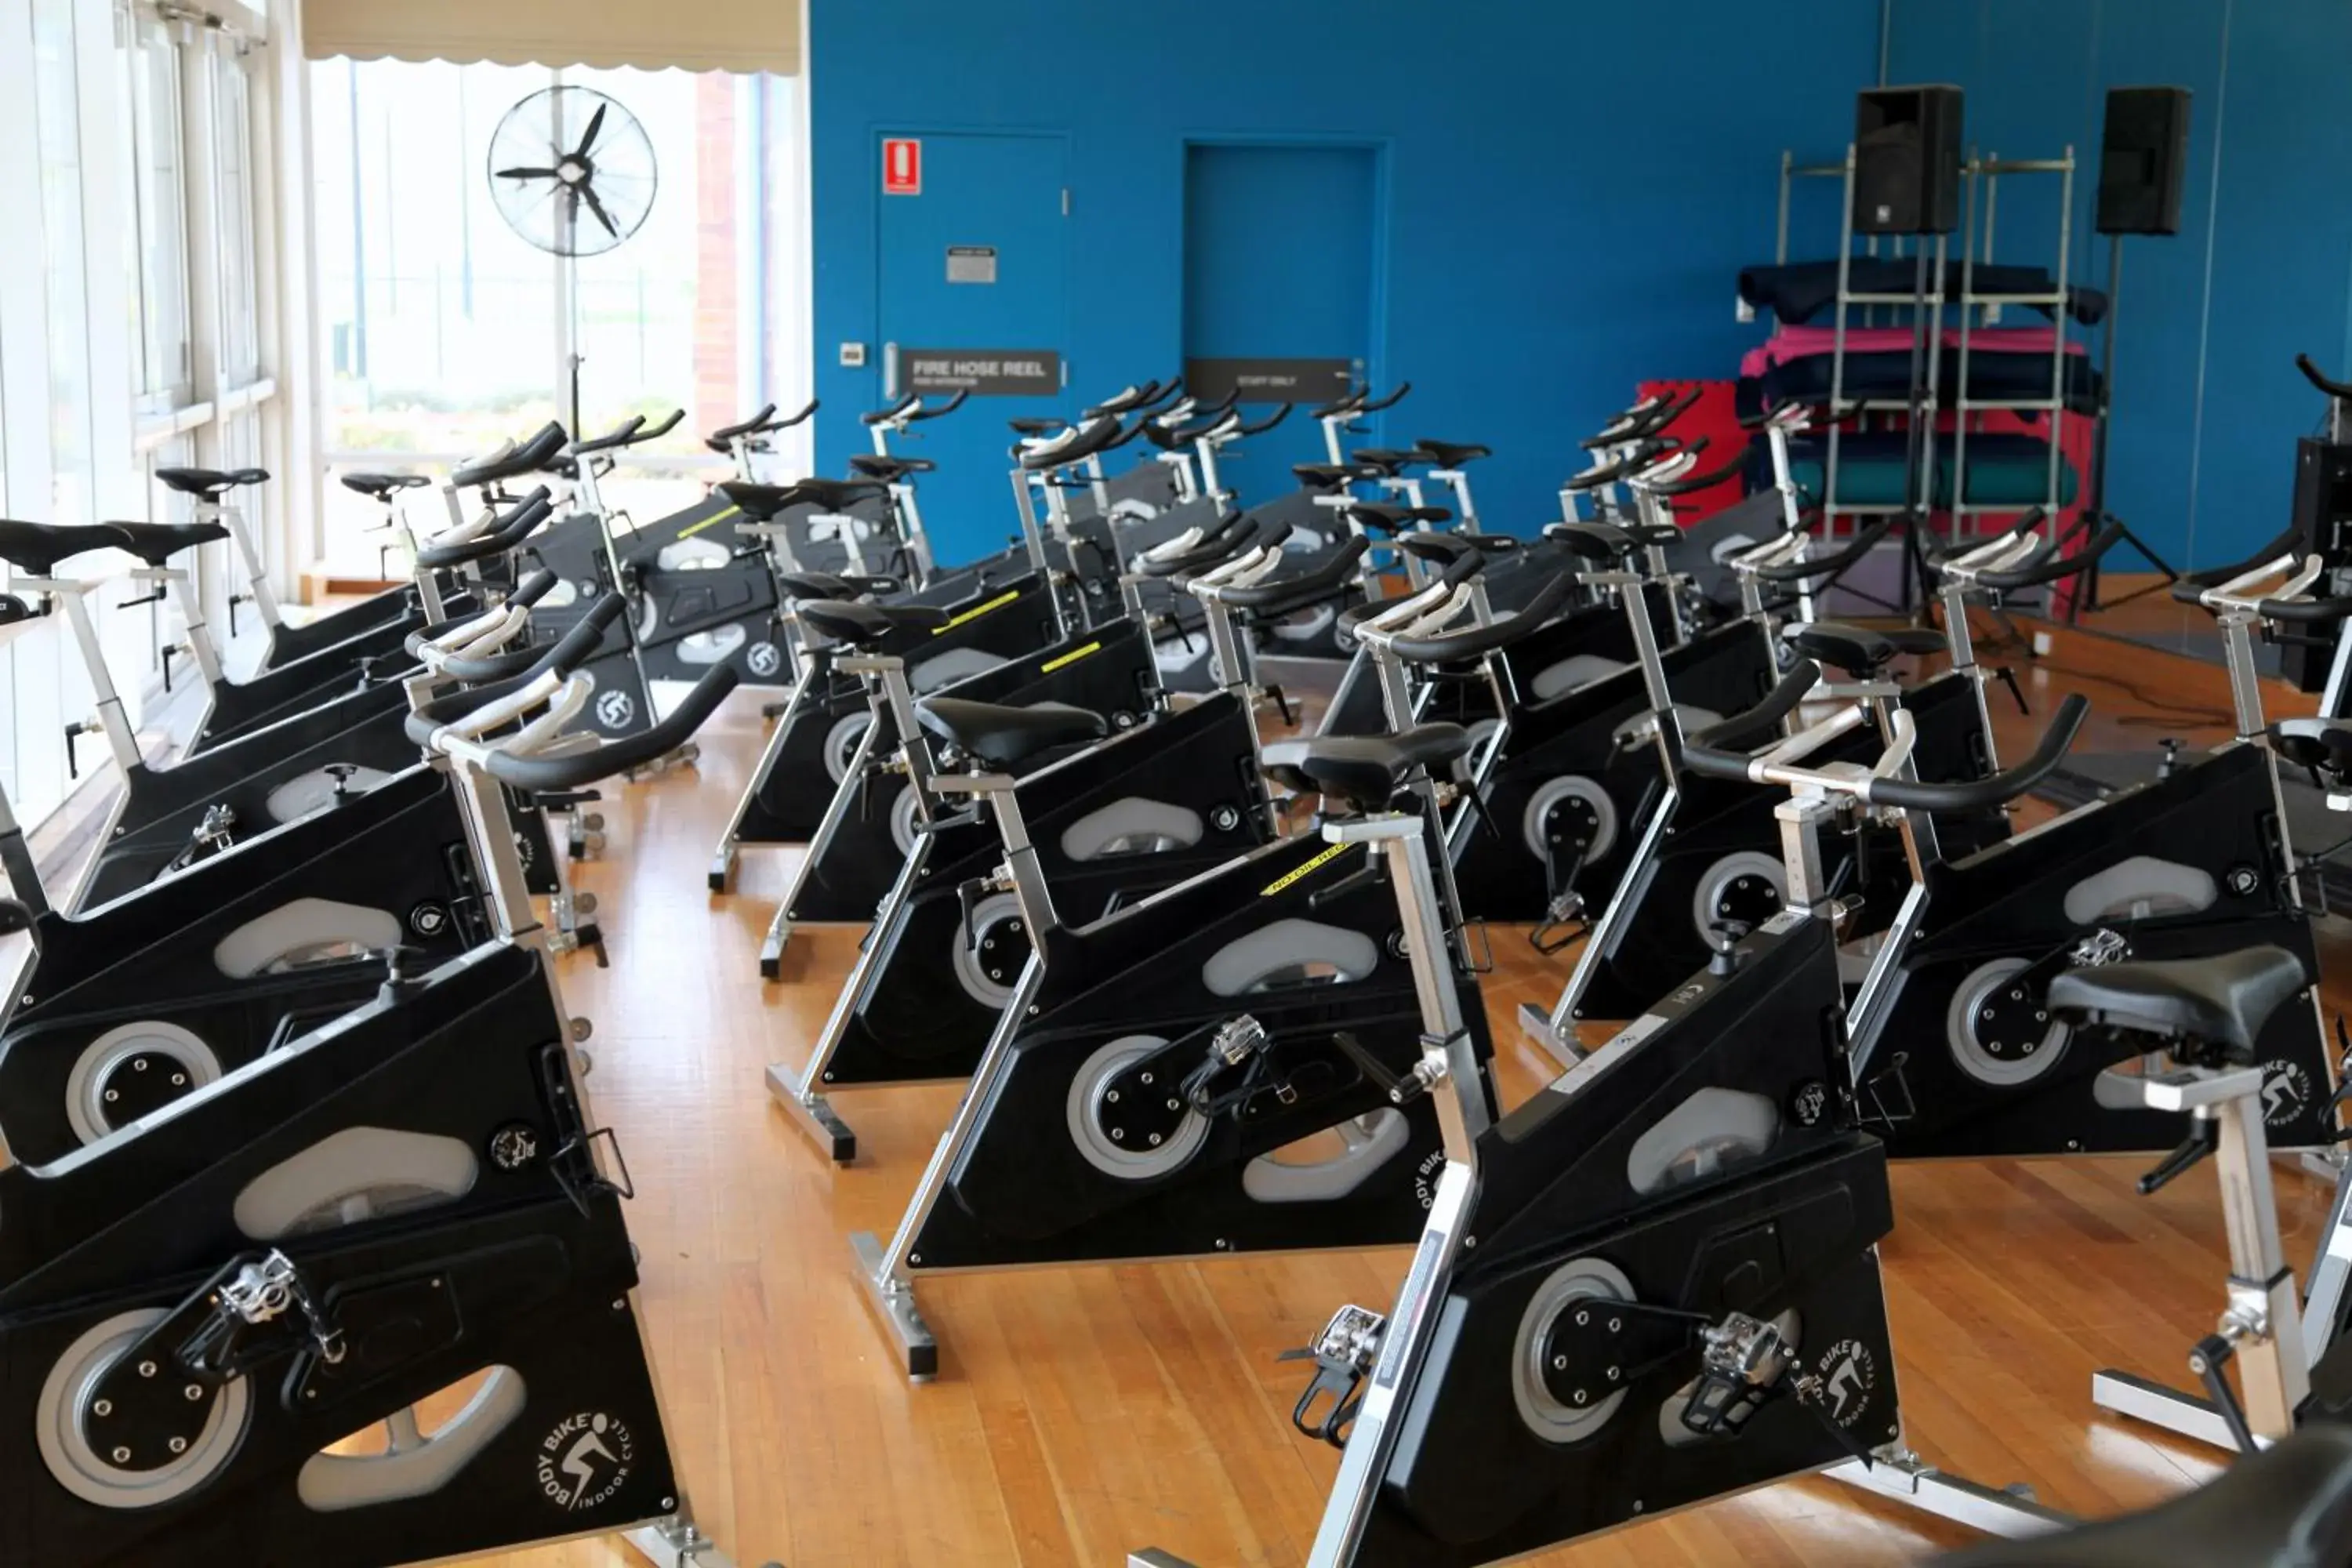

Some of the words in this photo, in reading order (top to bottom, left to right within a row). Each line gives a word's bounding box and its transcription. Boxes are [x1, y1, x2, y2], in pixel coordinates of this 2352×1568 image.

[913, 360, 950, 376] FIRE
[953, 360, 1000, 377] HOSE
[1003, 361, 1047, 378] REEL
[1418, 1150, 1444, 1176] BIK
[1414, 1176, 1432, 1210] ODY
[1819, 1340, 1852, 1372] BIKE
[543, 1413, 590, 1451] BIKE
[536, 1454, 572, 1506] BODY
[579, 1467, 629, 1510] INDOOR
